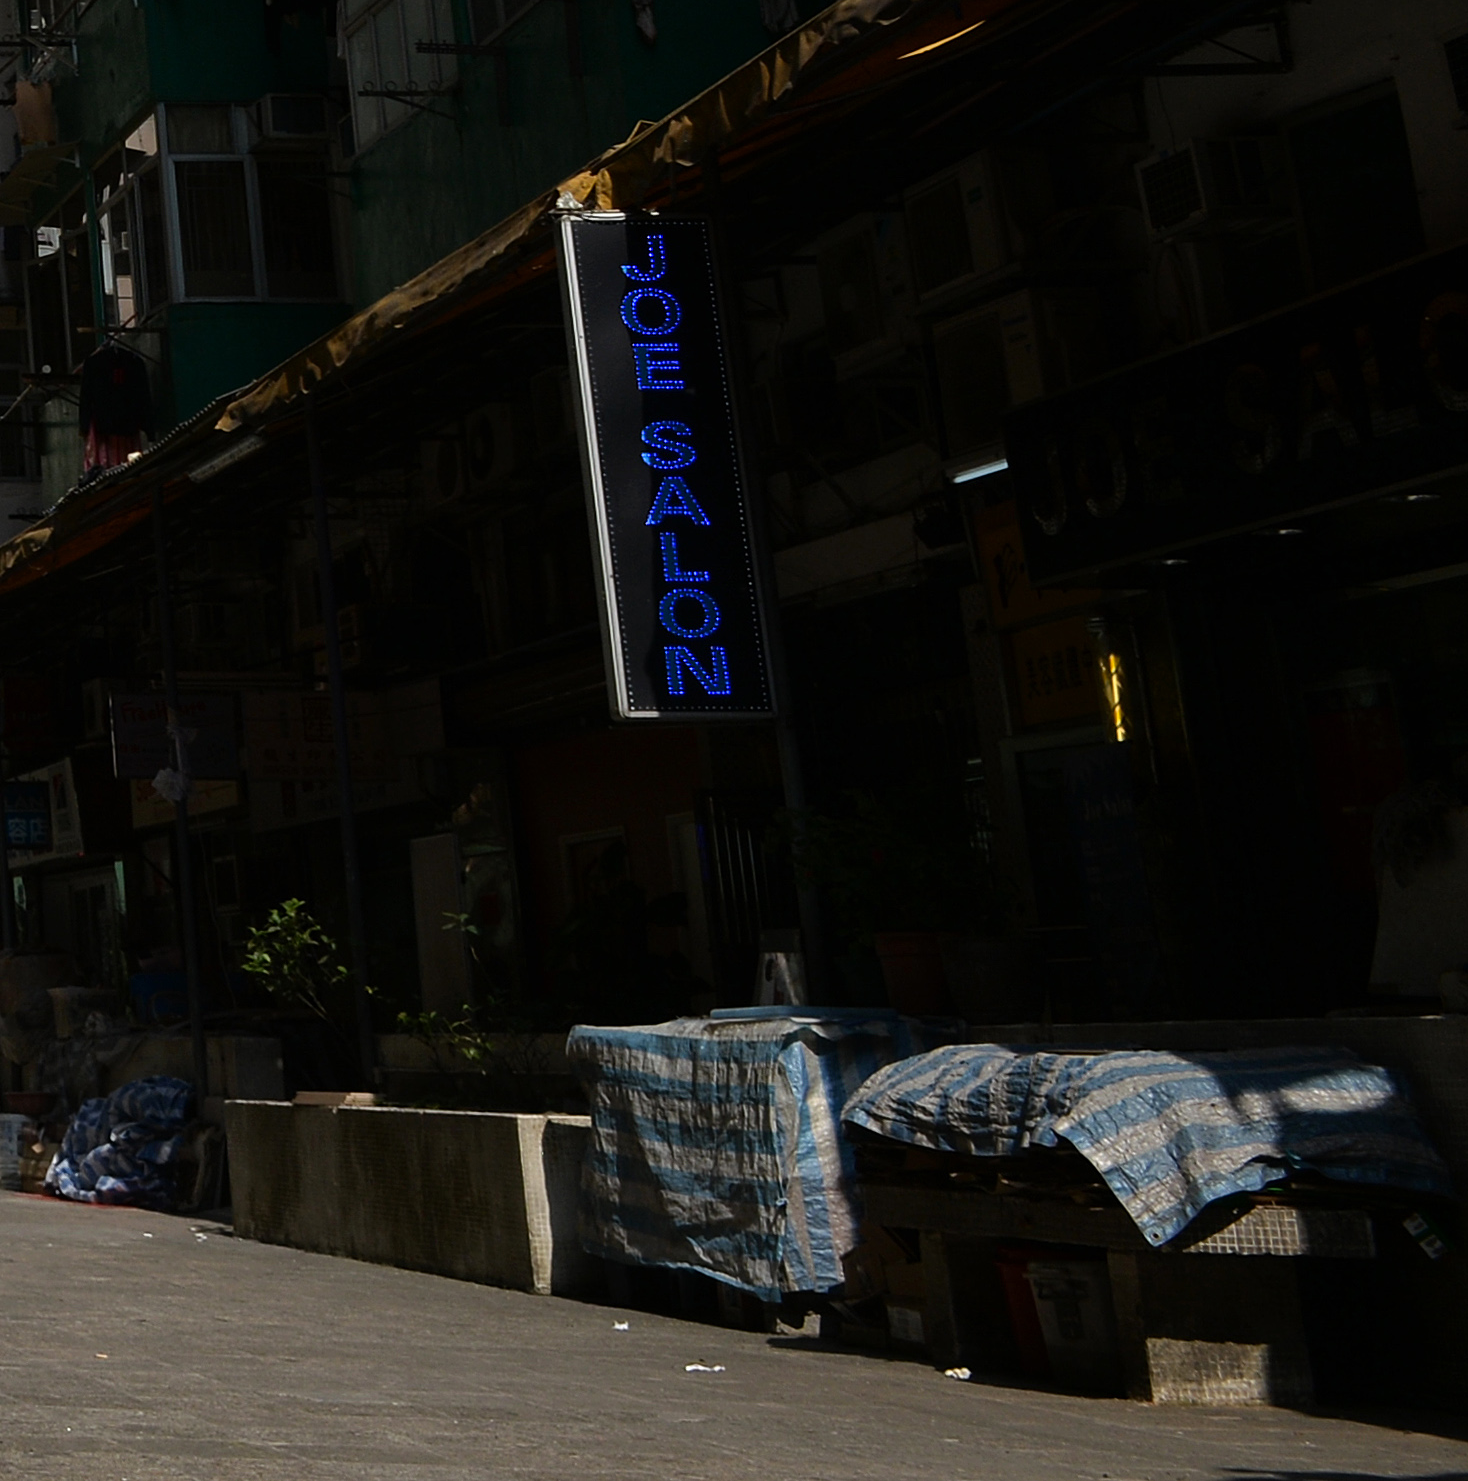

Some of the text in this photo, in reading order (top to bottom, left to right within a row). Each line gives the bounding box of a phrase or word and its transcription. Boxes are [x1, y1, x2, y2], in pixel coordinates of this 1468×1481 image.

[619, 232, 733, 697] JOE SALON
[1031, 394, 1185, 538] JOE
